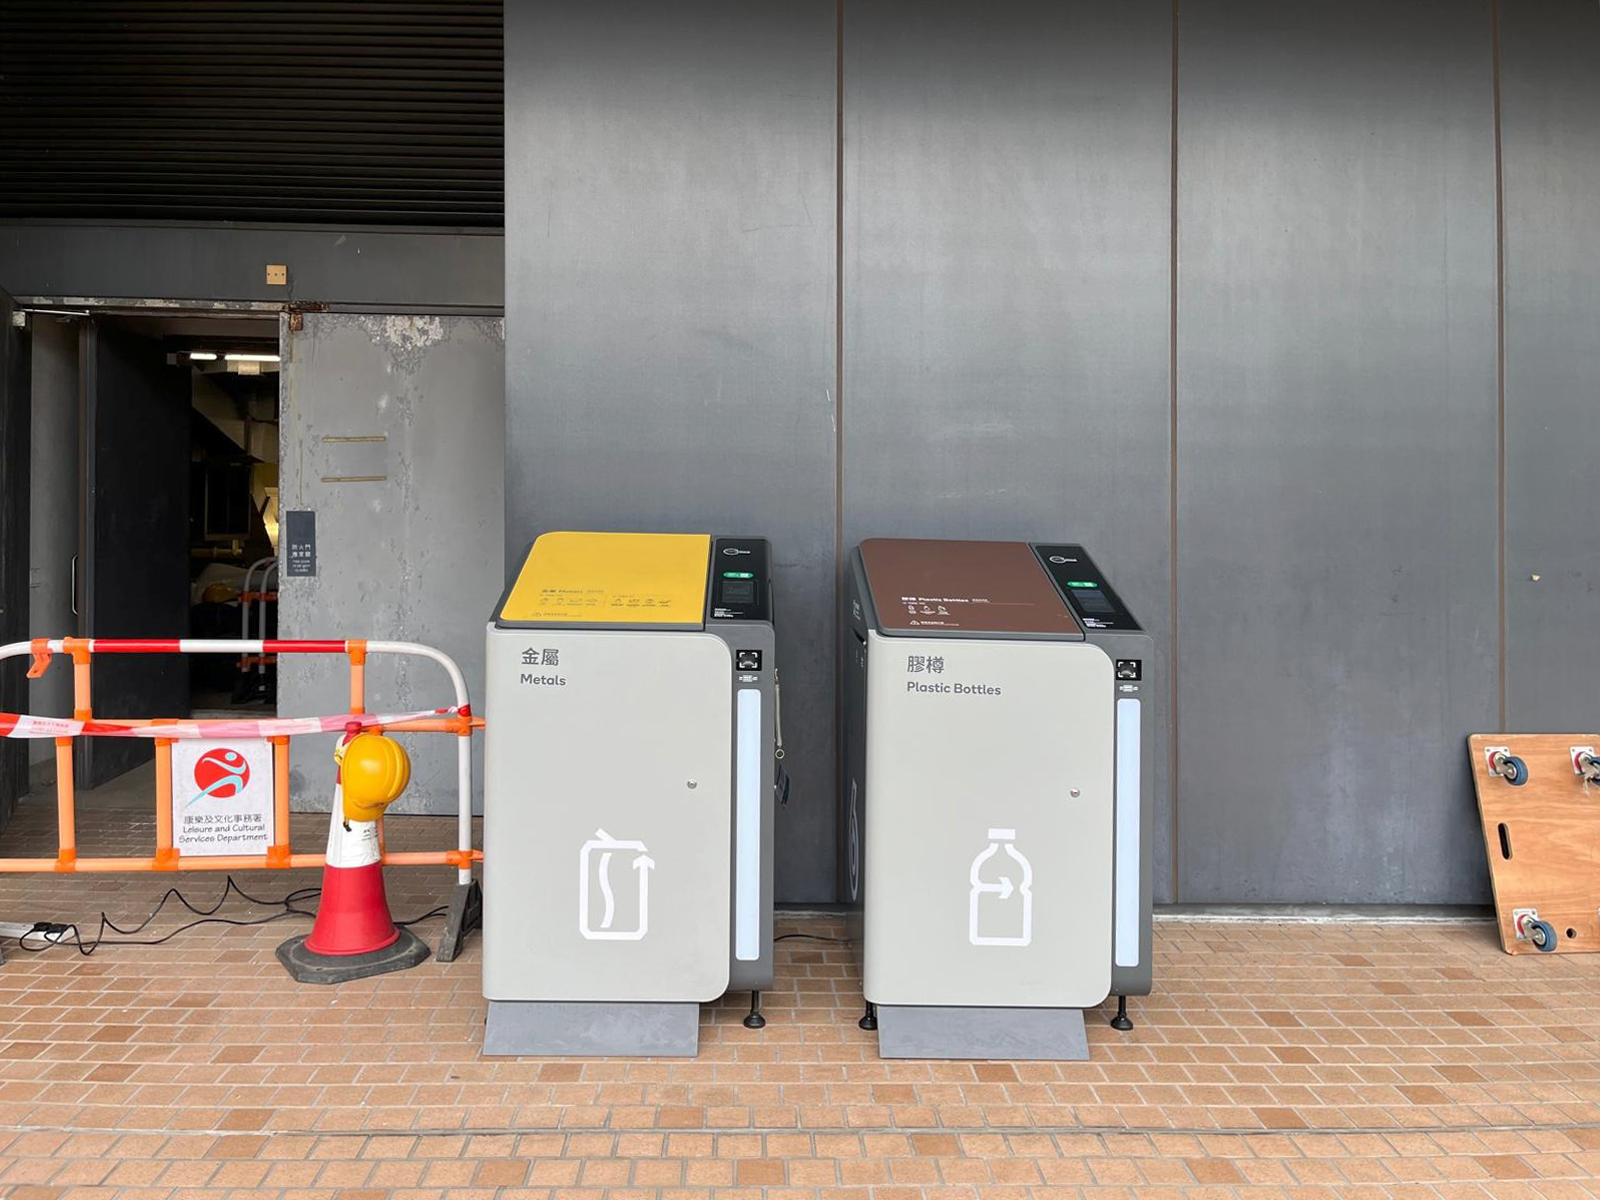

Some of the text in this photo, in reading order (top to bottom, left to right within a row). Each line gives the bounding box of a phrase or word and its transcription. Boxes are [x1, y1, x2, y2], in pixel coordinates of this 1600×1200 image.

[521, 647, 559, 666] 金屬
[907, 656, 945, 673] 膠樽
[520, 674, 566, 686] Metals
[907, 682, 1001, 695] Plastic Bottles
[184, 814, 262, 824] 康樂及文化事務署
[183, 825, 213, 833] Leisure
[232, 824, 265, 832] Cultural
[179, 834, 268, 844] Services Department
